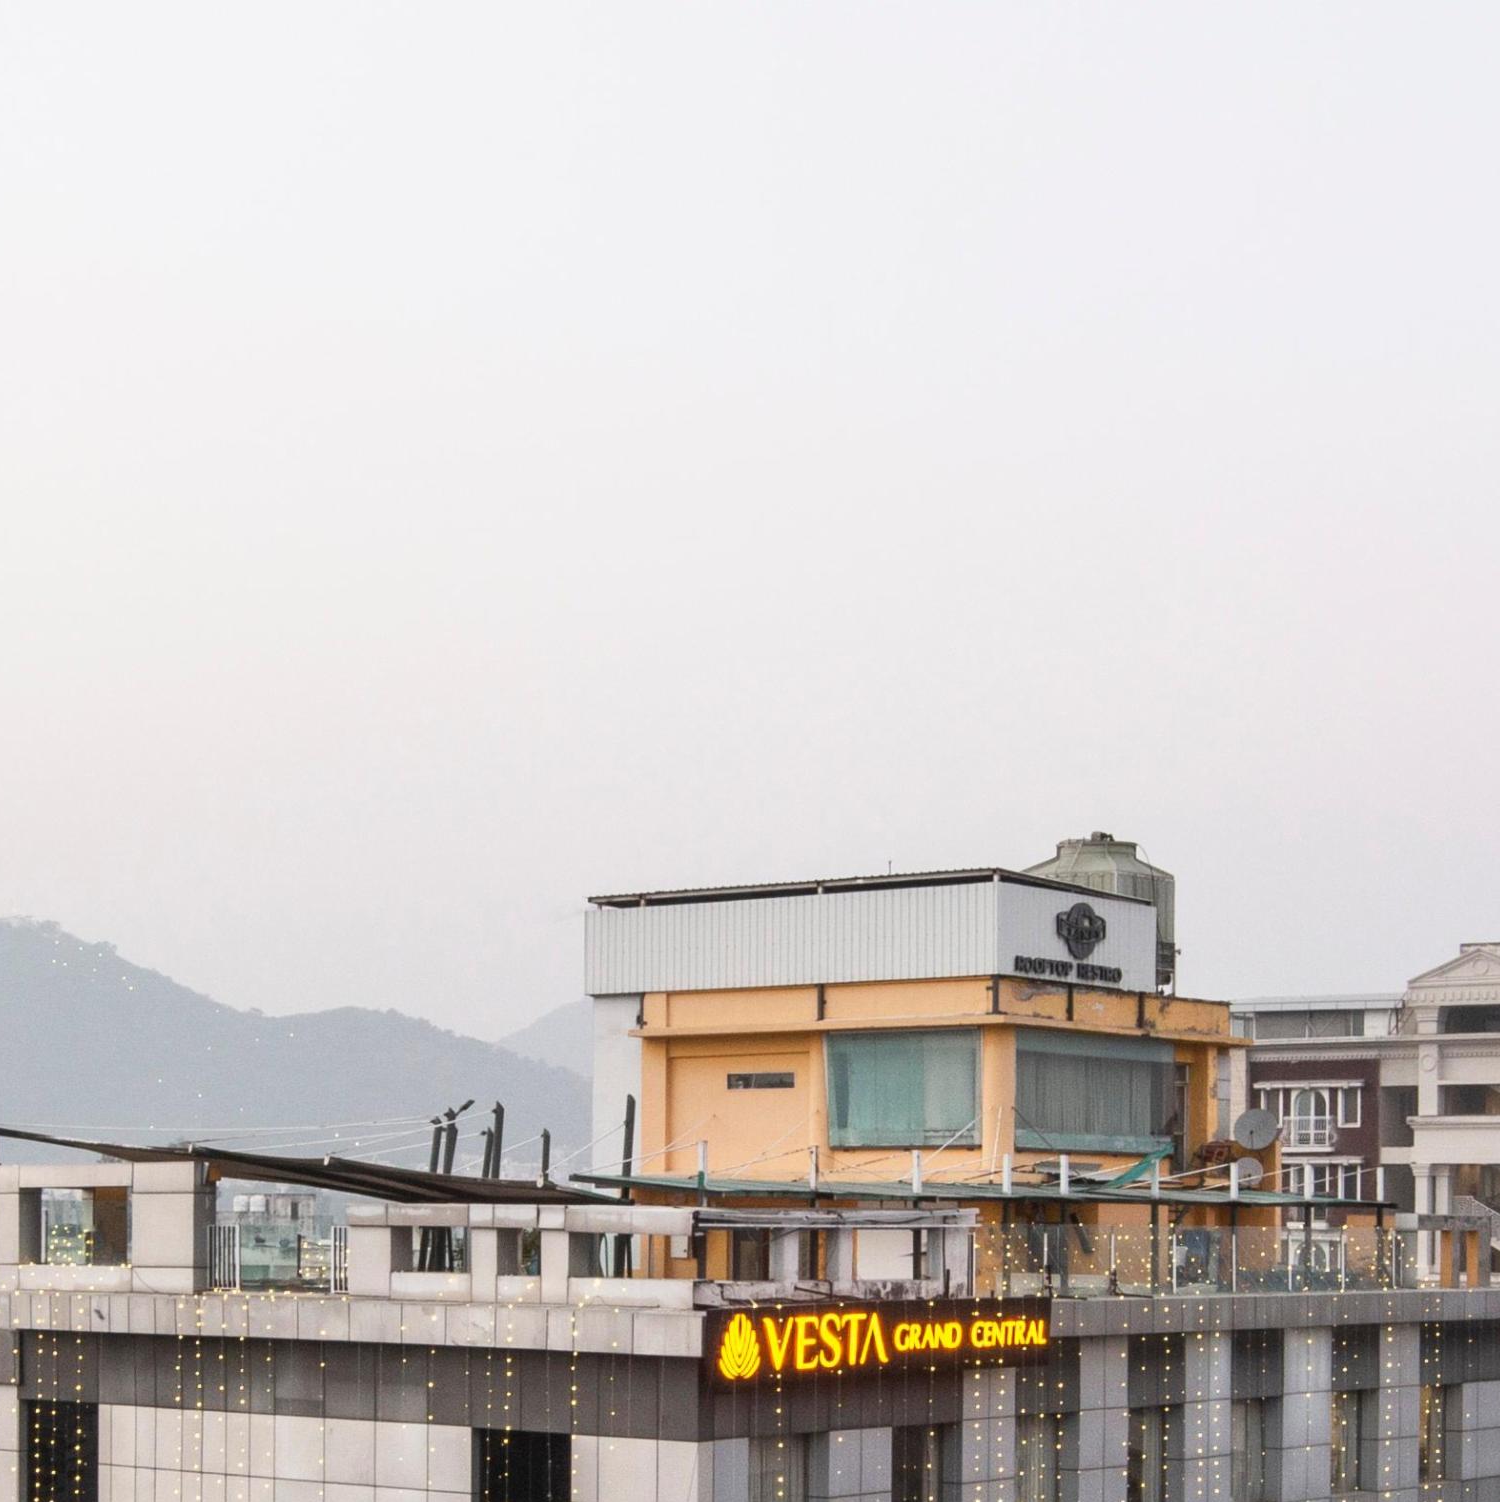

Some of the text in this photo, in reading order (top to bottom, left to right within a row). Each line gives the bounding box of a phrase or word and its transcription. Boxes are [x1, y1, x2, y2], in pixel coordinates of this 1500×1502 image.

[1014, 955, 1122, 983] ROOFTOP RESTRO
[763, 1313, 1047, 1371] VESTA GRAND CENTRAL
